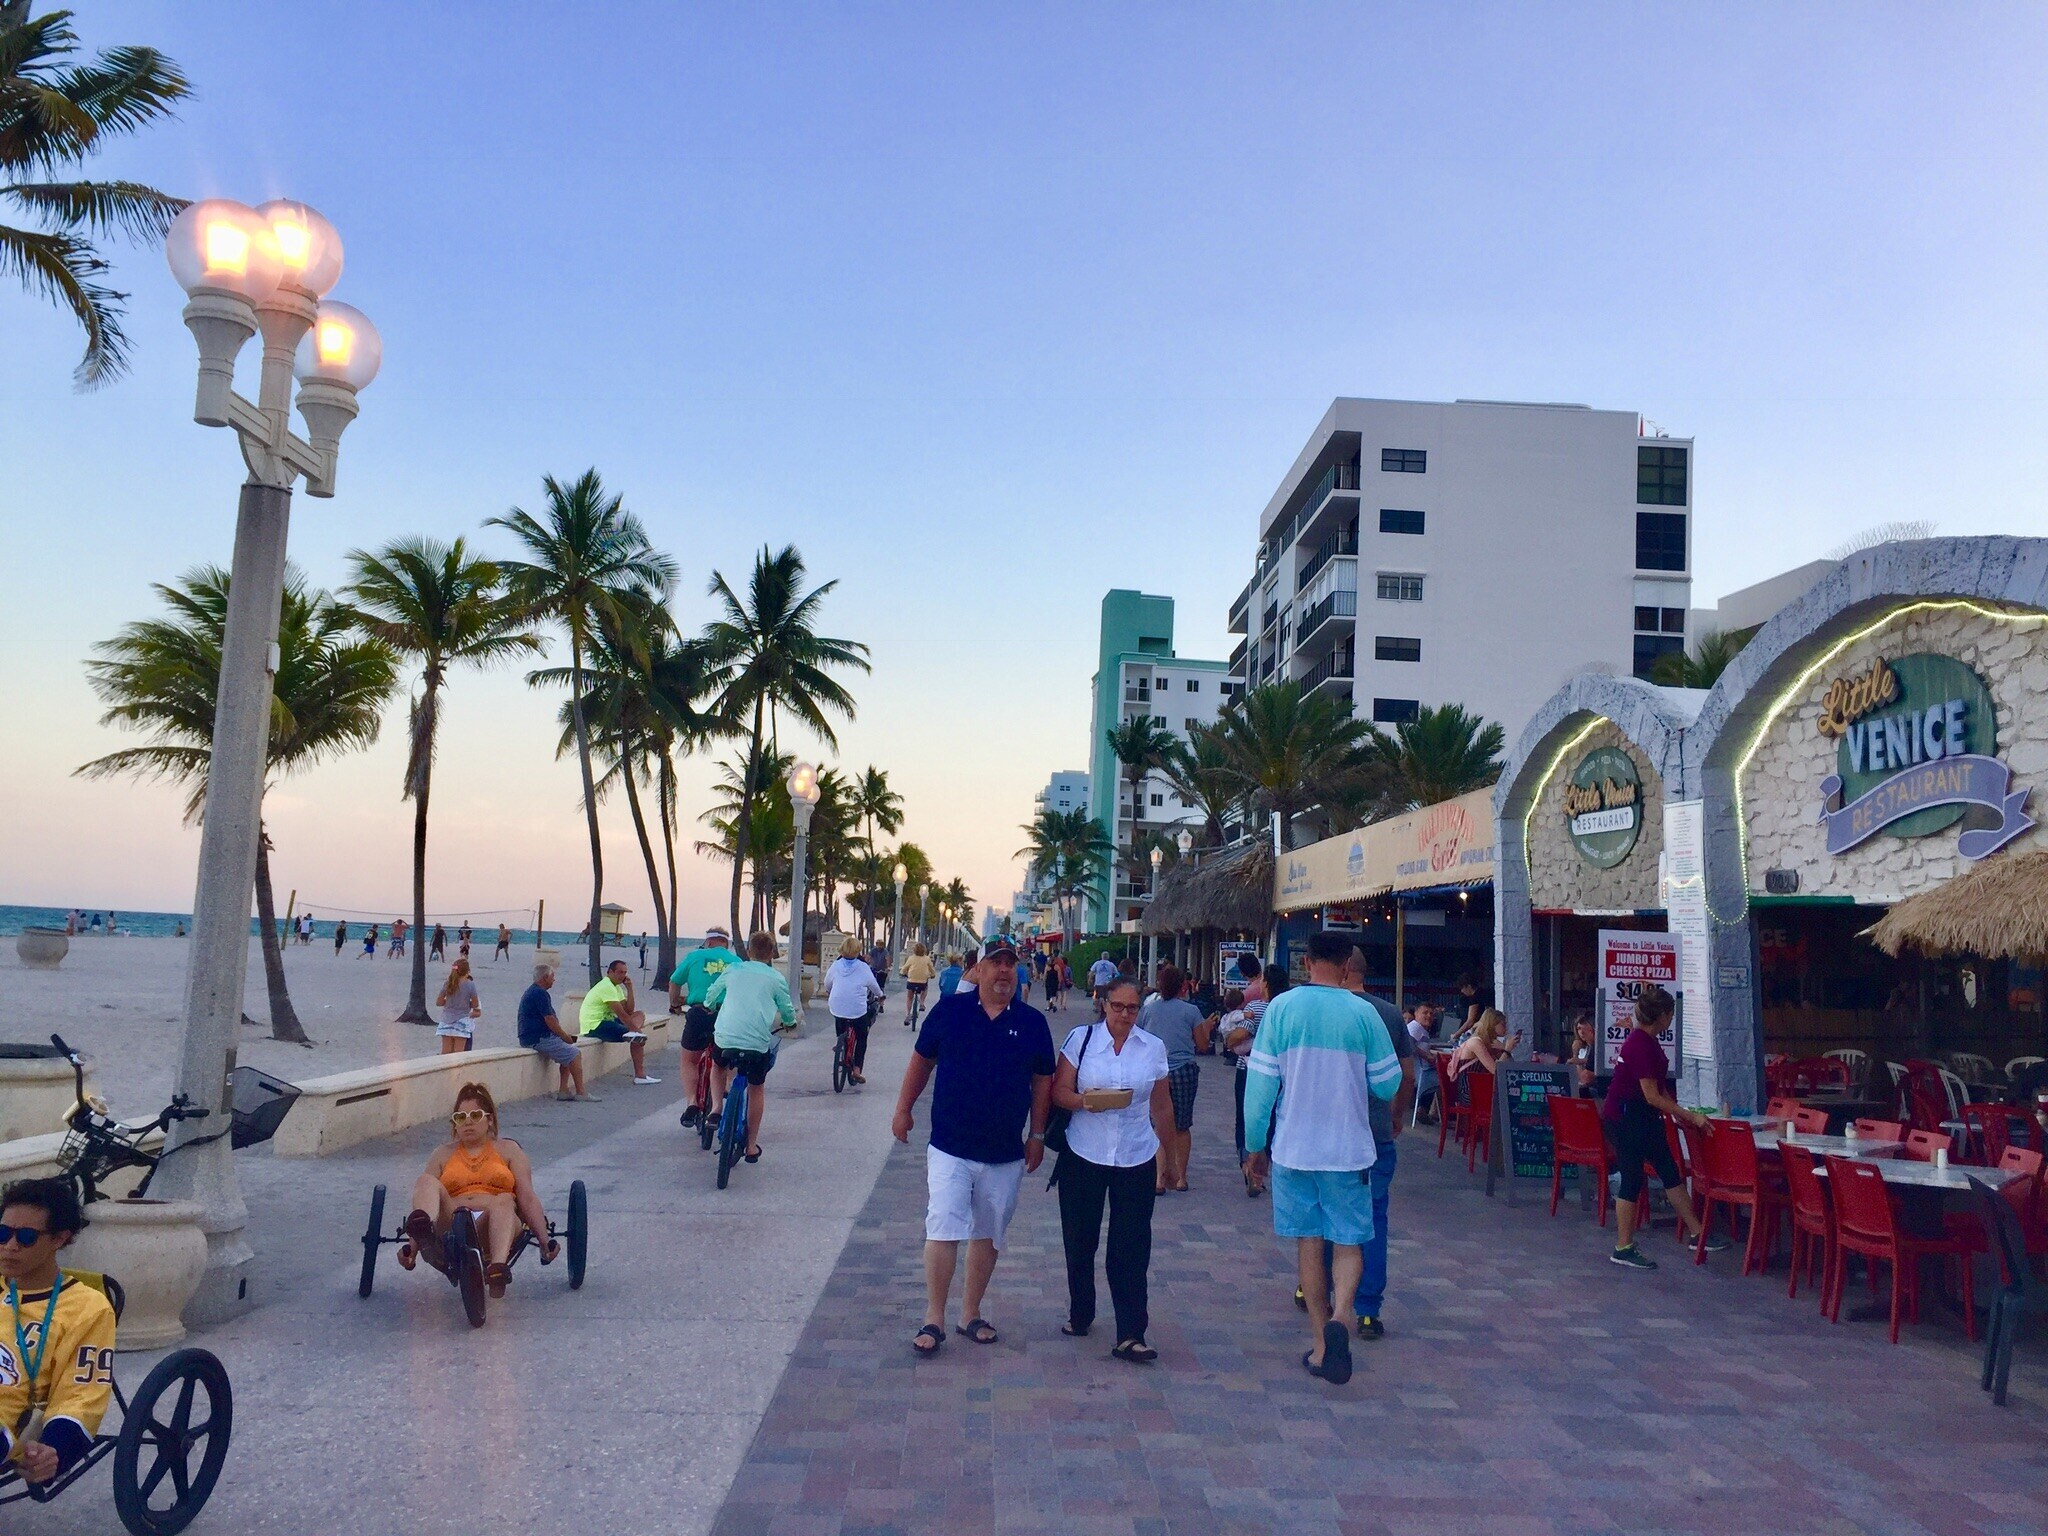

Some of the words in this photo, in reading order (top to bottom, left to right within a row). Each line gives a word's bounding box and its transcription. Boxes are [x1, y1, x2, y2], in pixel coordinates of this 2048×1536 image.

[1817, 656, 1898, 737] Little
[1846, 699, 1967, 773] VENICE
[1562, 781, 1601, 816] Little
[1852, 764, 1973, 834] RESTAURANT
[1577, 812, 1629, 830] RESTAURANT
[1607, 939, 1631, 949] Welcome
[1640, 940, 1655, 950] Little
[1657, 941, 1674, 951] Venice
[1609, 965, 1644, 977] CHEESE
[1646, 967, 1672, 978] PIZZA
[1615, 953, 1648, 965] JUMBO
[1521, 1072, 1552, 1082] SPECIALS
[74, 1345, 114, 1384] 59
